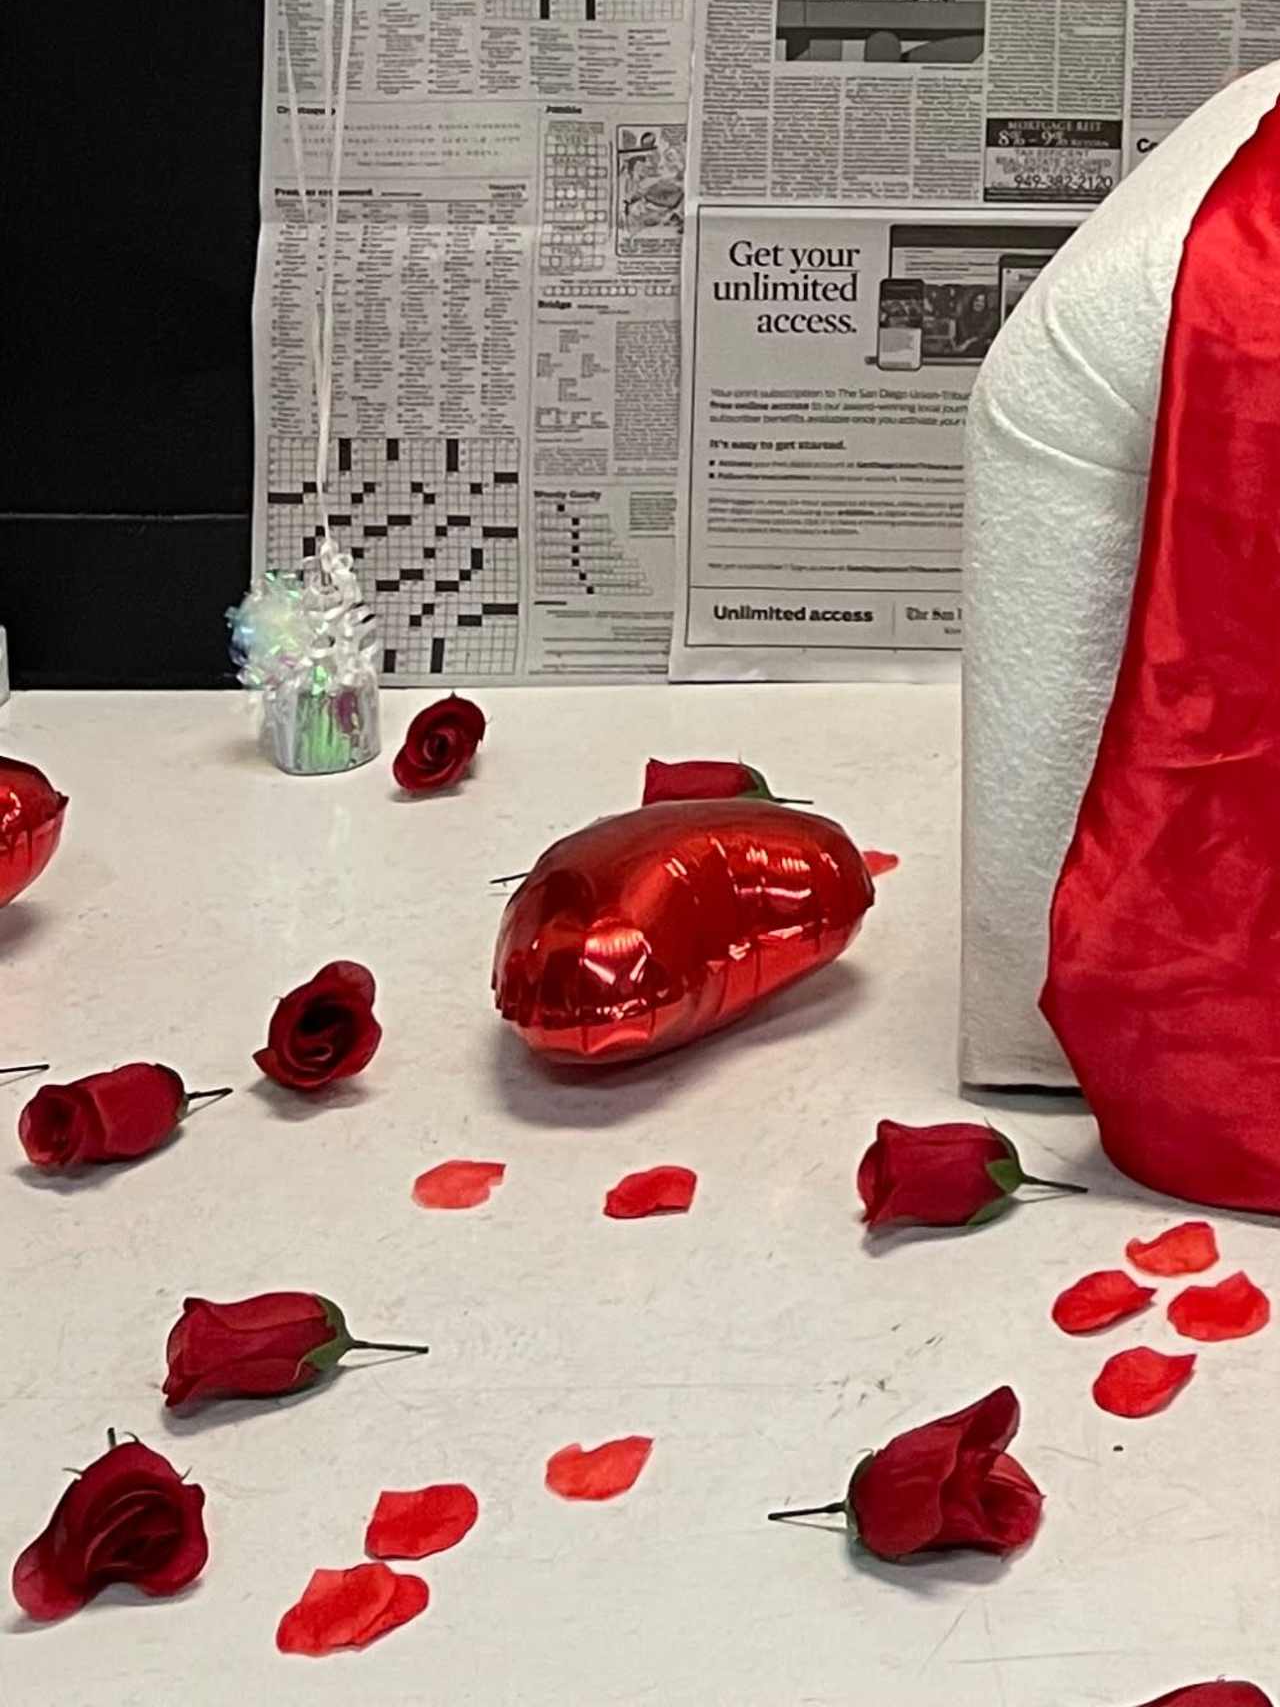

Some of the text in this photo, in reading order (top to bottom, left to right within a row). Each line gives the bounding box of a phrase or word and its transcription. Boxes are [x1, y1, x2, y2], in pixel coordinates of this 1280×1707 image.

[729, 240, 860, 274] Get your
[714, 271, 858, 302] unlimited
[757, 314, 857, 334] access.
[713, 605, 873, 622] Unlimited access
